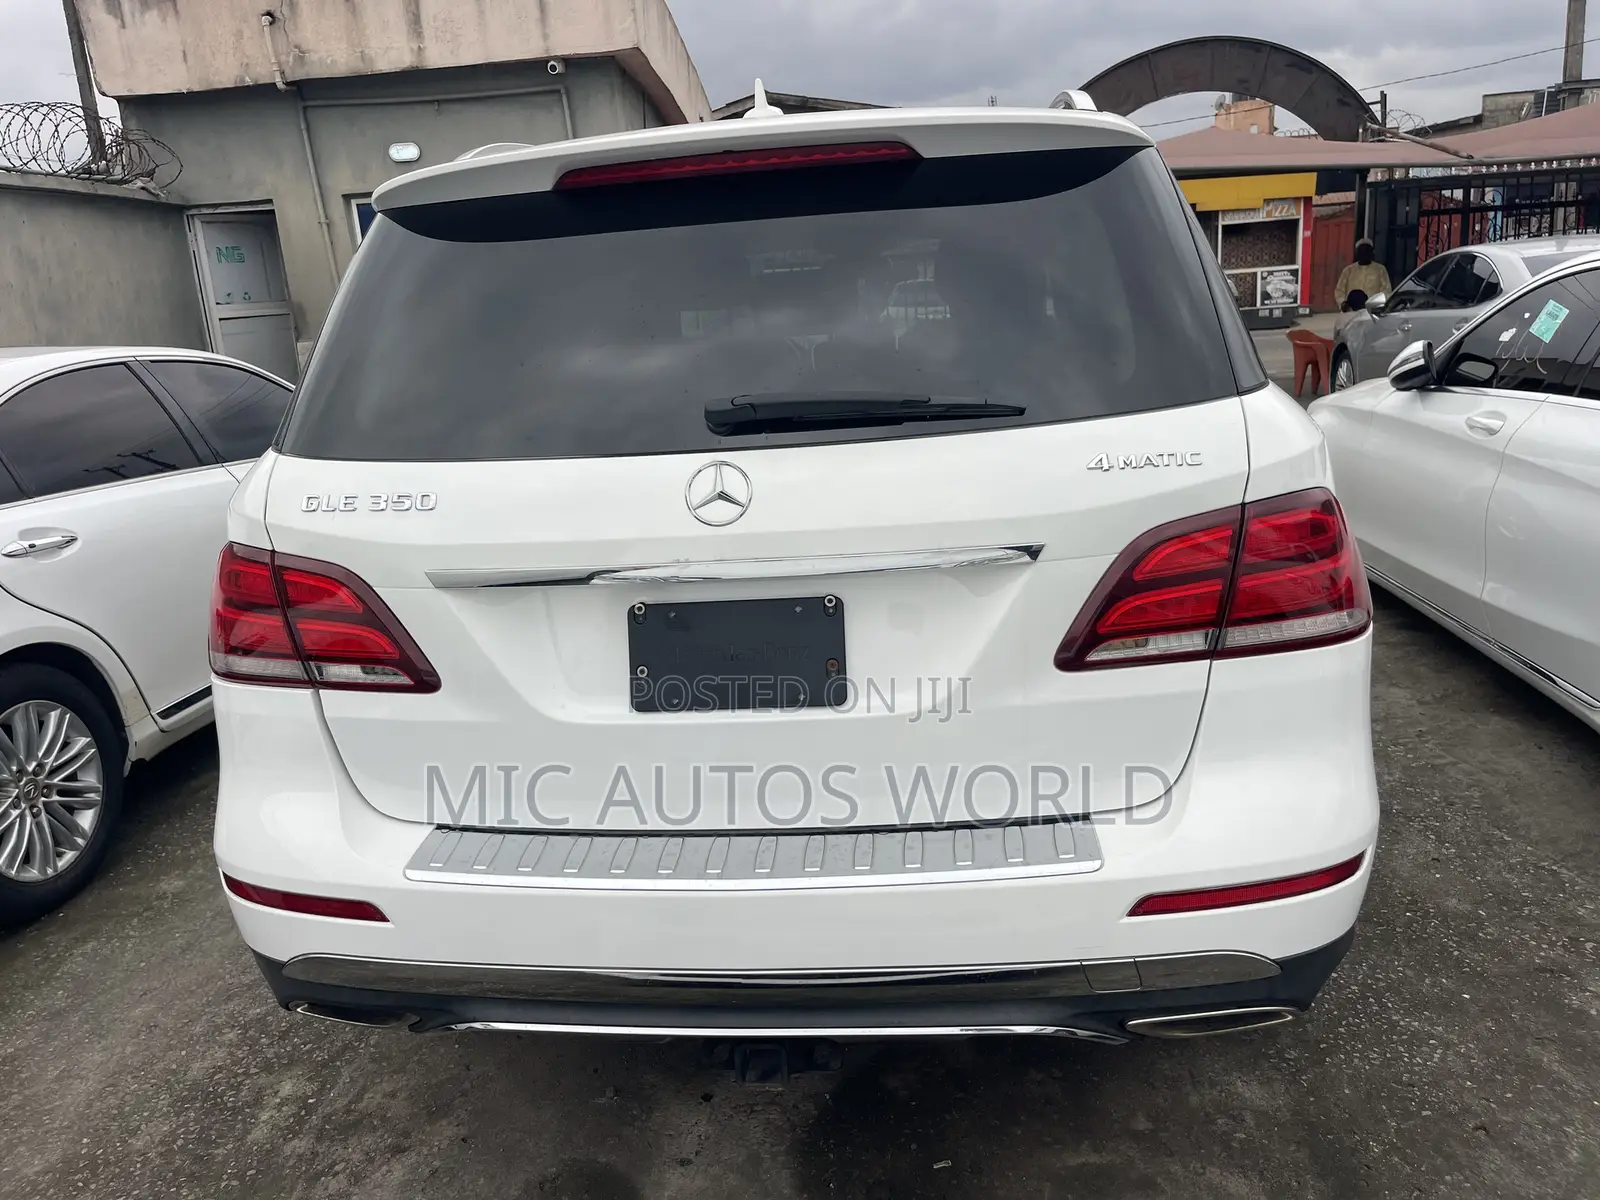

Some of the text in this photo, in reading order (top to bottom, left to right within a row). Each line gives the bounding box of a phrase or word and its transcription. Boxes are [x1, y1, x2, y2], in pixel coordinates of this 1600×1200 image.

[1263, 200, 1297, 218] PIZZA
[301, 492, 437, 512] GLE 350
